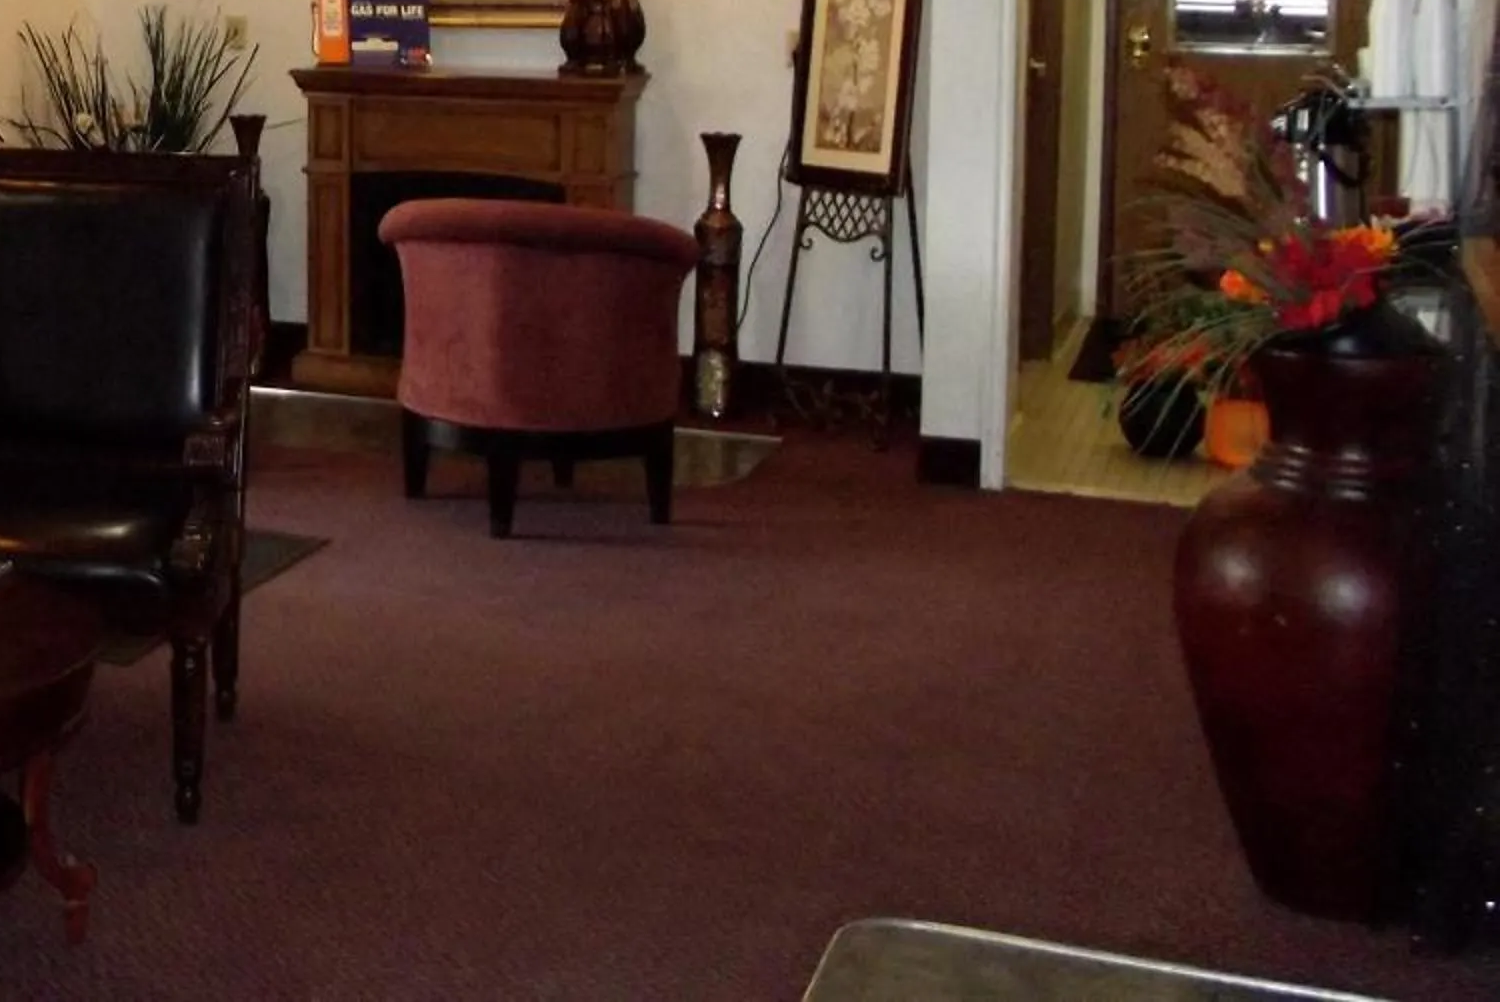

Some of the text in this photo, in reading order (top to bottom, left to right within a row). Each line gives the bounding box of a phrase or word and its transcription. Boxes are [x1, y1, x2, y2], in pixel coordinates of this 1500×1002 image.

[351, 4, 424, 18] GAS FOR LIFE
